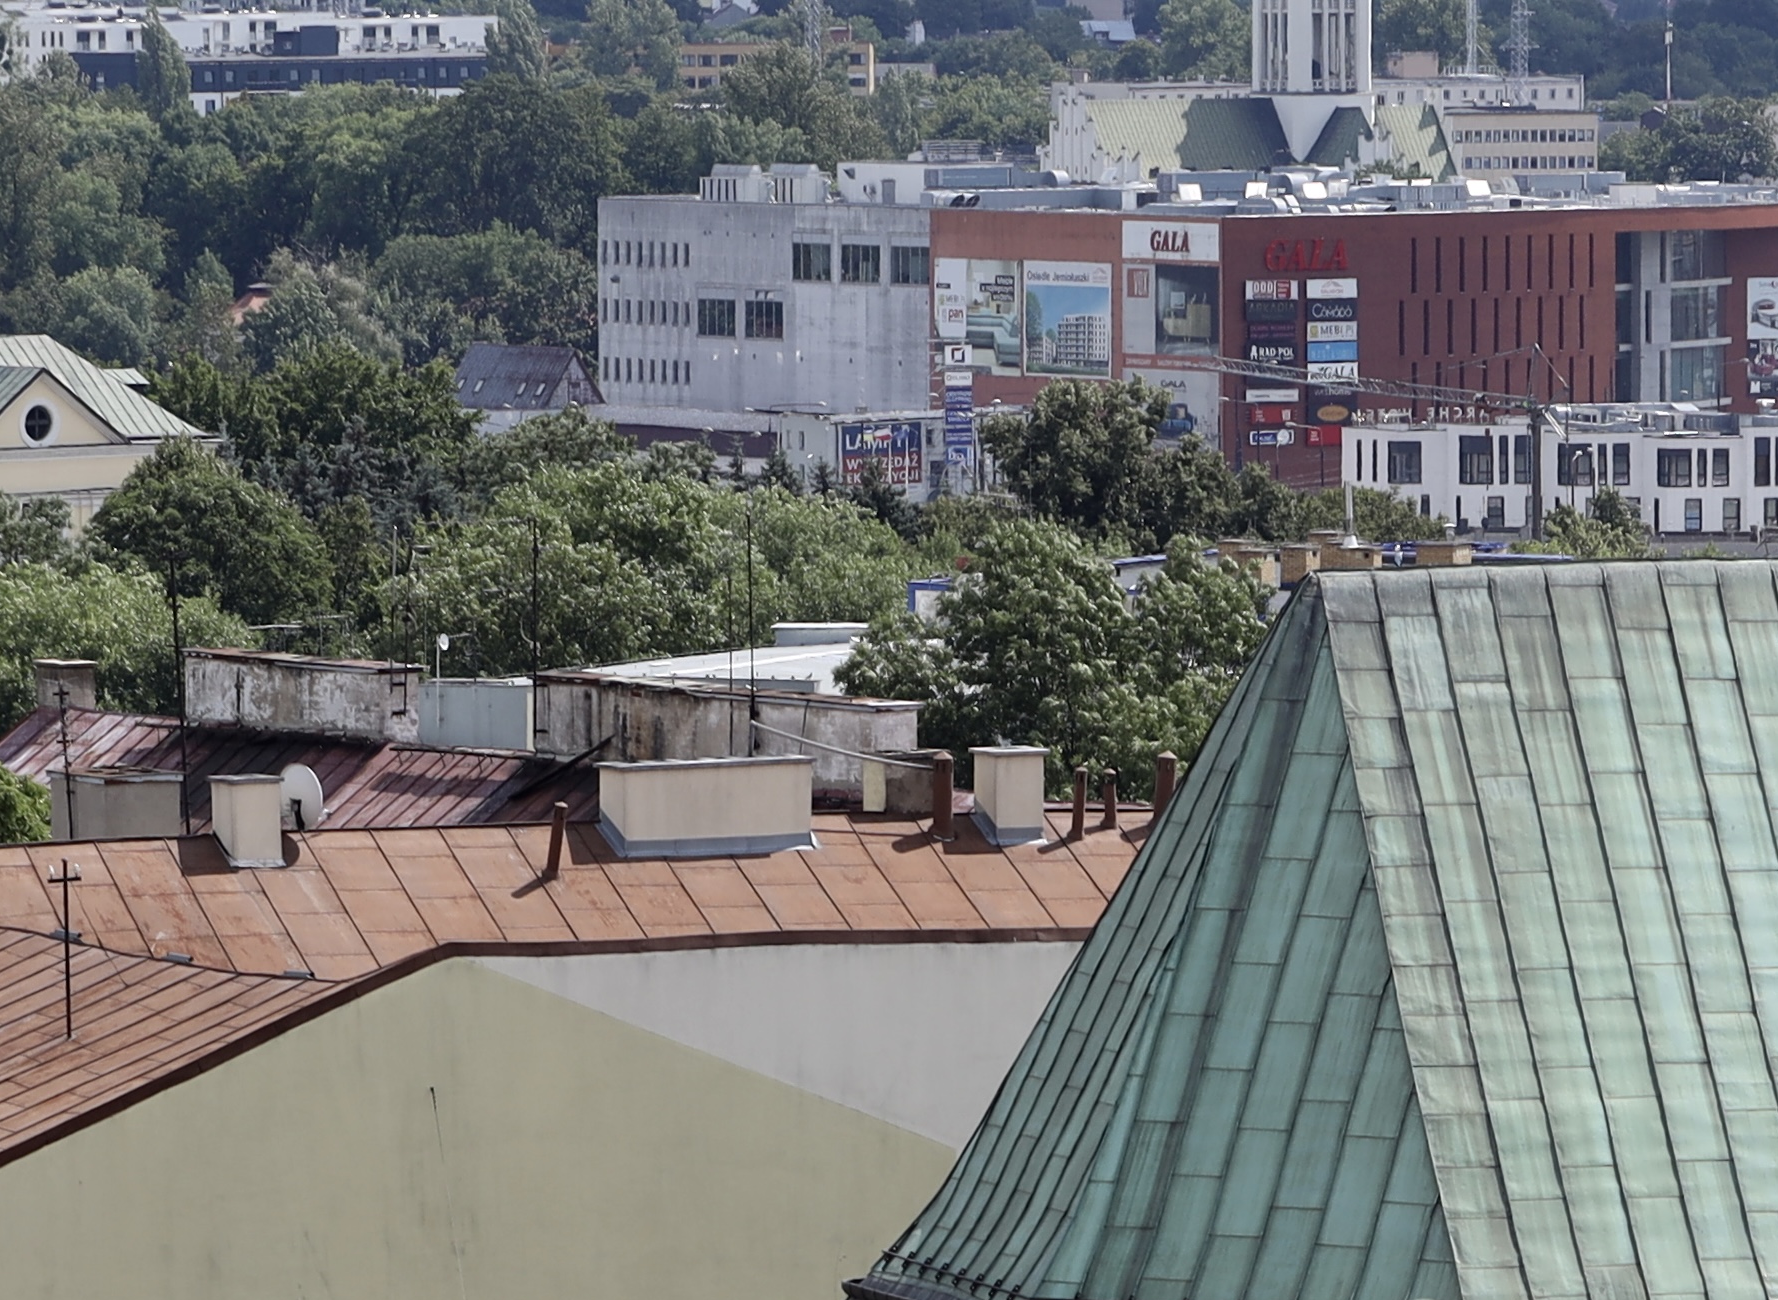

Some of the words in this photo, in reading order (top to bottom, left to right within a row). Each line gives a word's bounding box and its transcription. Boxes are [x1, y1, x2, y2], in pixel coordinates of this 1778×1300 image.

[1149, 229, 1191, 254] GALA
[1264, 237, 1349, 273] GALA
[1159, 379, 1187, 388] GALA
